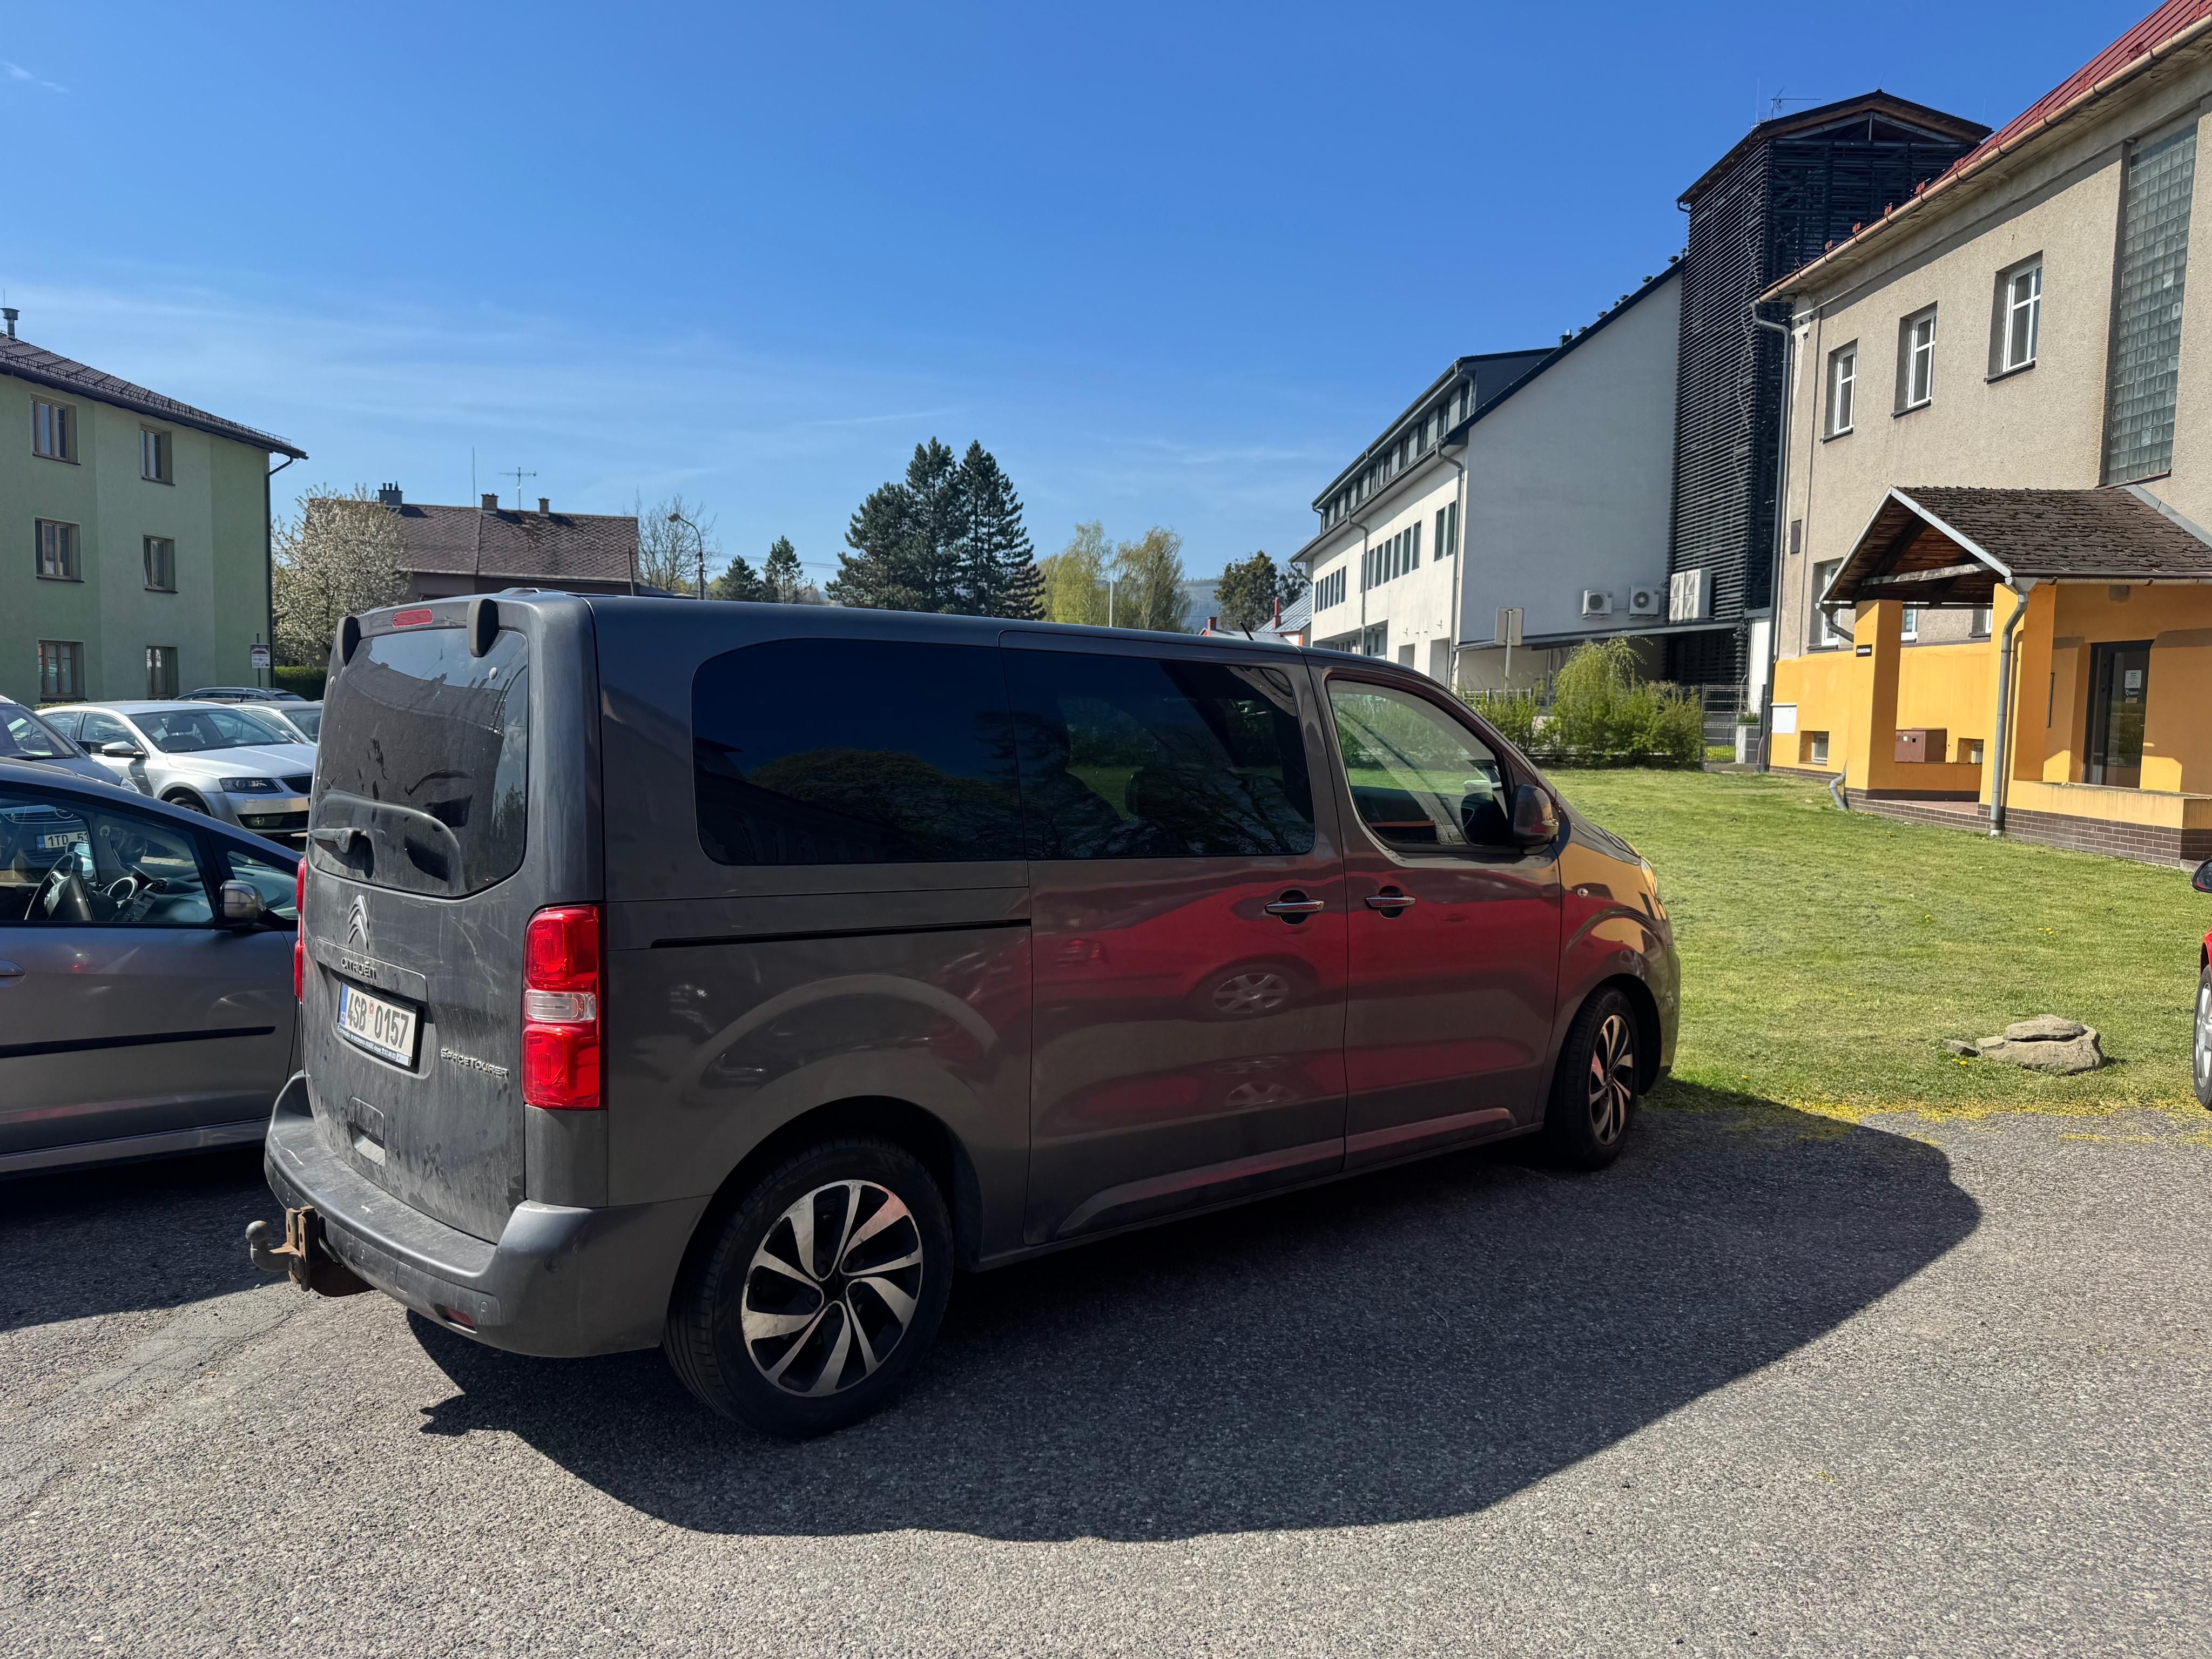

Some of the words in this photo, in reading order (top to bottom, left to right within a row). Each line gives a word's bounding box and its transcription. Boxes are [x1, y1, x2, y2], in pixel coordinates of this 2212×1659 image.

[48, 834, 69, 847] 1TD
[347, 993, 367, 1032] 4SB
[374, 1004, 409, 1049] 0157
